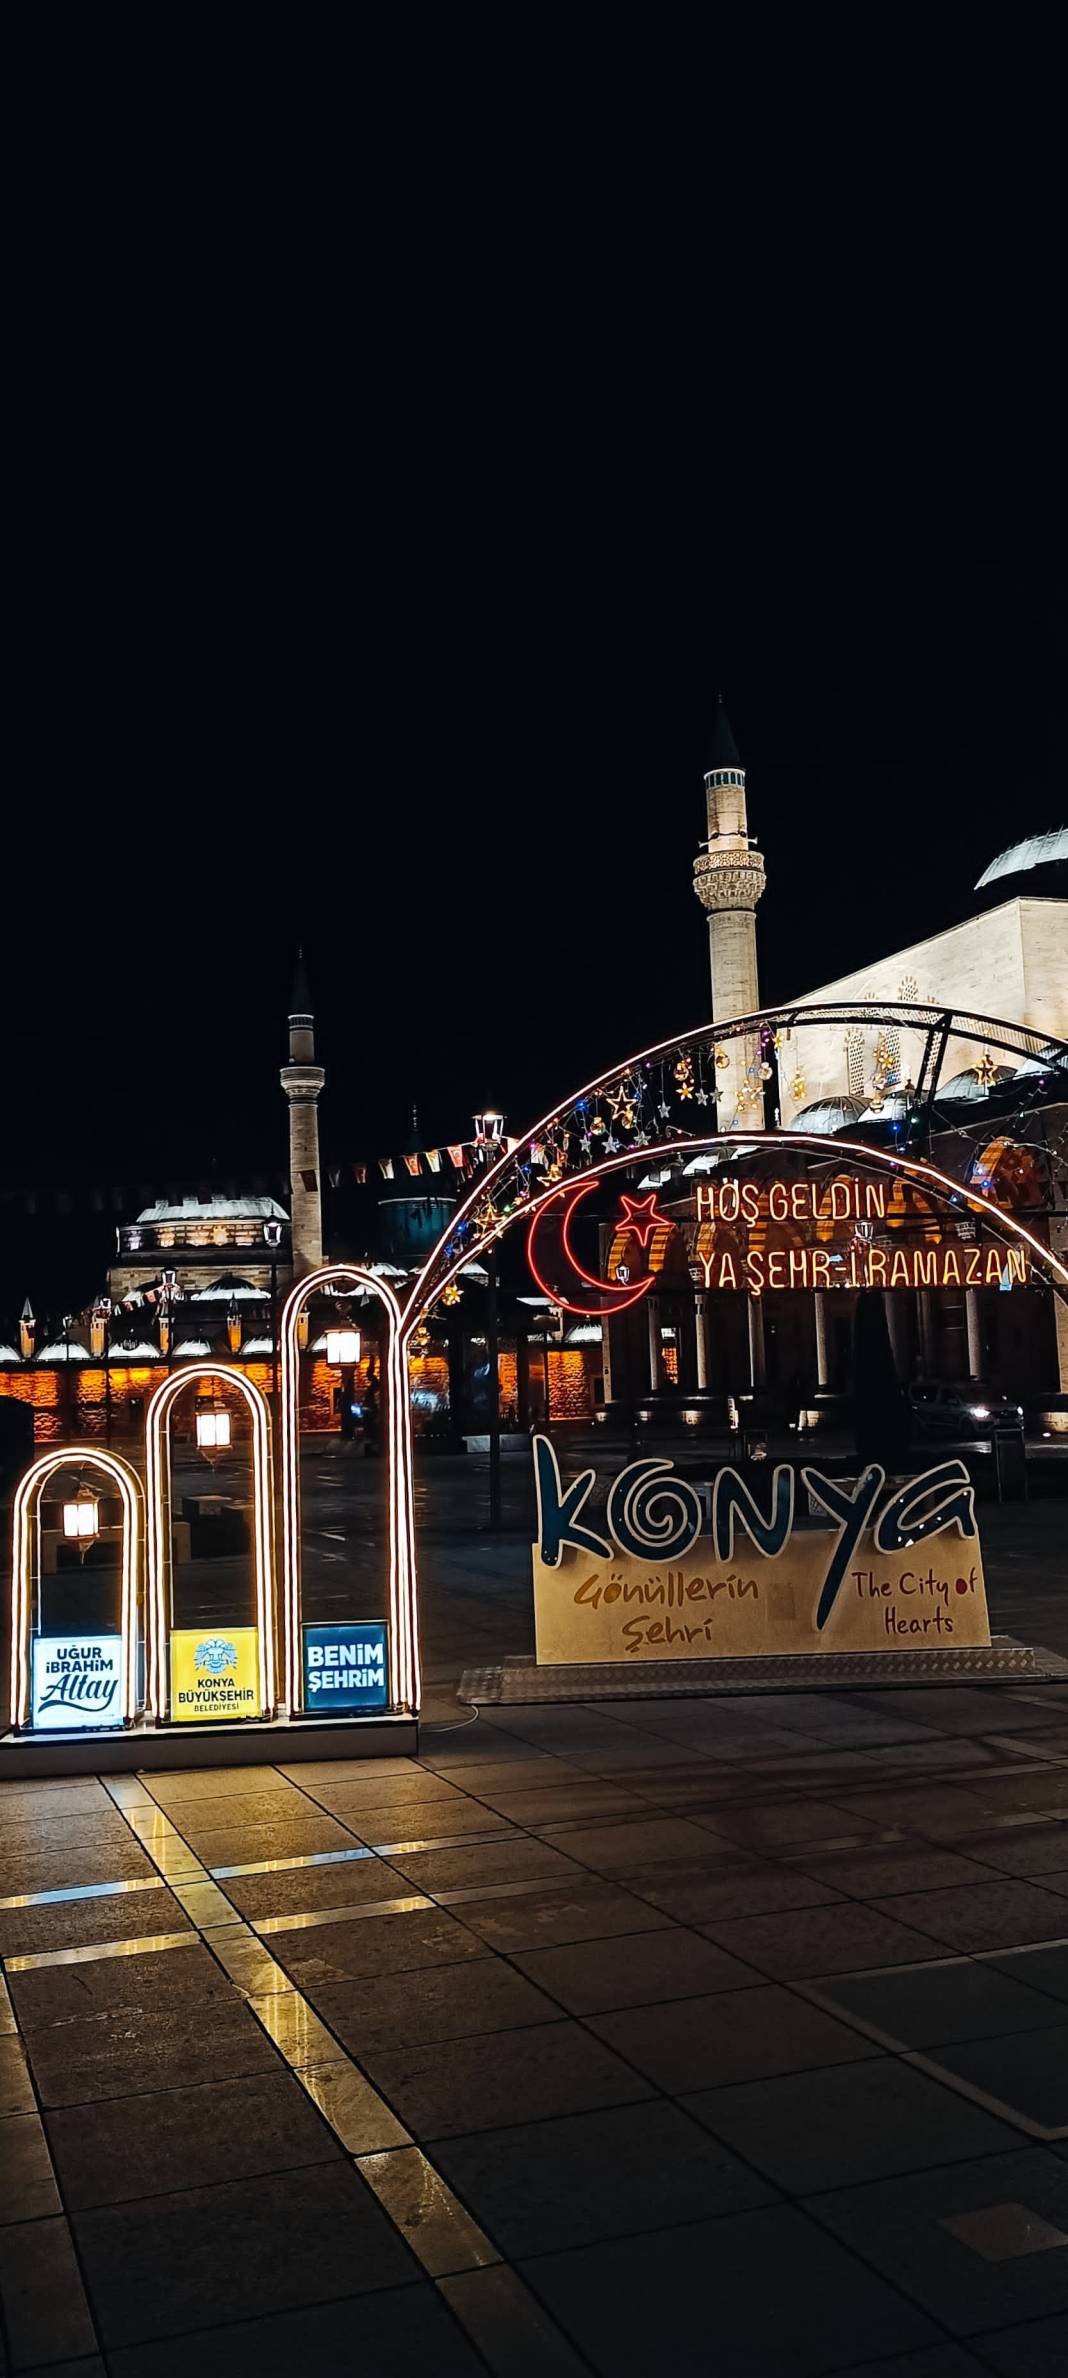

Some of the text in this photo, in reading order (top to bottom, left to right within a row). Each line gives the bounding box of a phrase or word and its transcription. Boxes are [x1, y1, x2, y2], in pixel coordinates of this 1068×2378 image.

[769, 1177, 885, 1220] GELDİN
[699, 1251, 736, 1288] YA
[868, 1249, 1027, 1287] RAMAZAN
[574, 1572, 758, 1609] Gönüllerin
[852, 1567, 978, 1607] The City of
[622, 1615, 713, 1653] Şehri
[885, 1606, 954, 1635] Hearts
[57, 1644, 102, 1660] UĞUR
[38, 1674, 118, 1713] Altay
[197, 1678, 235, 1689] KONYA
